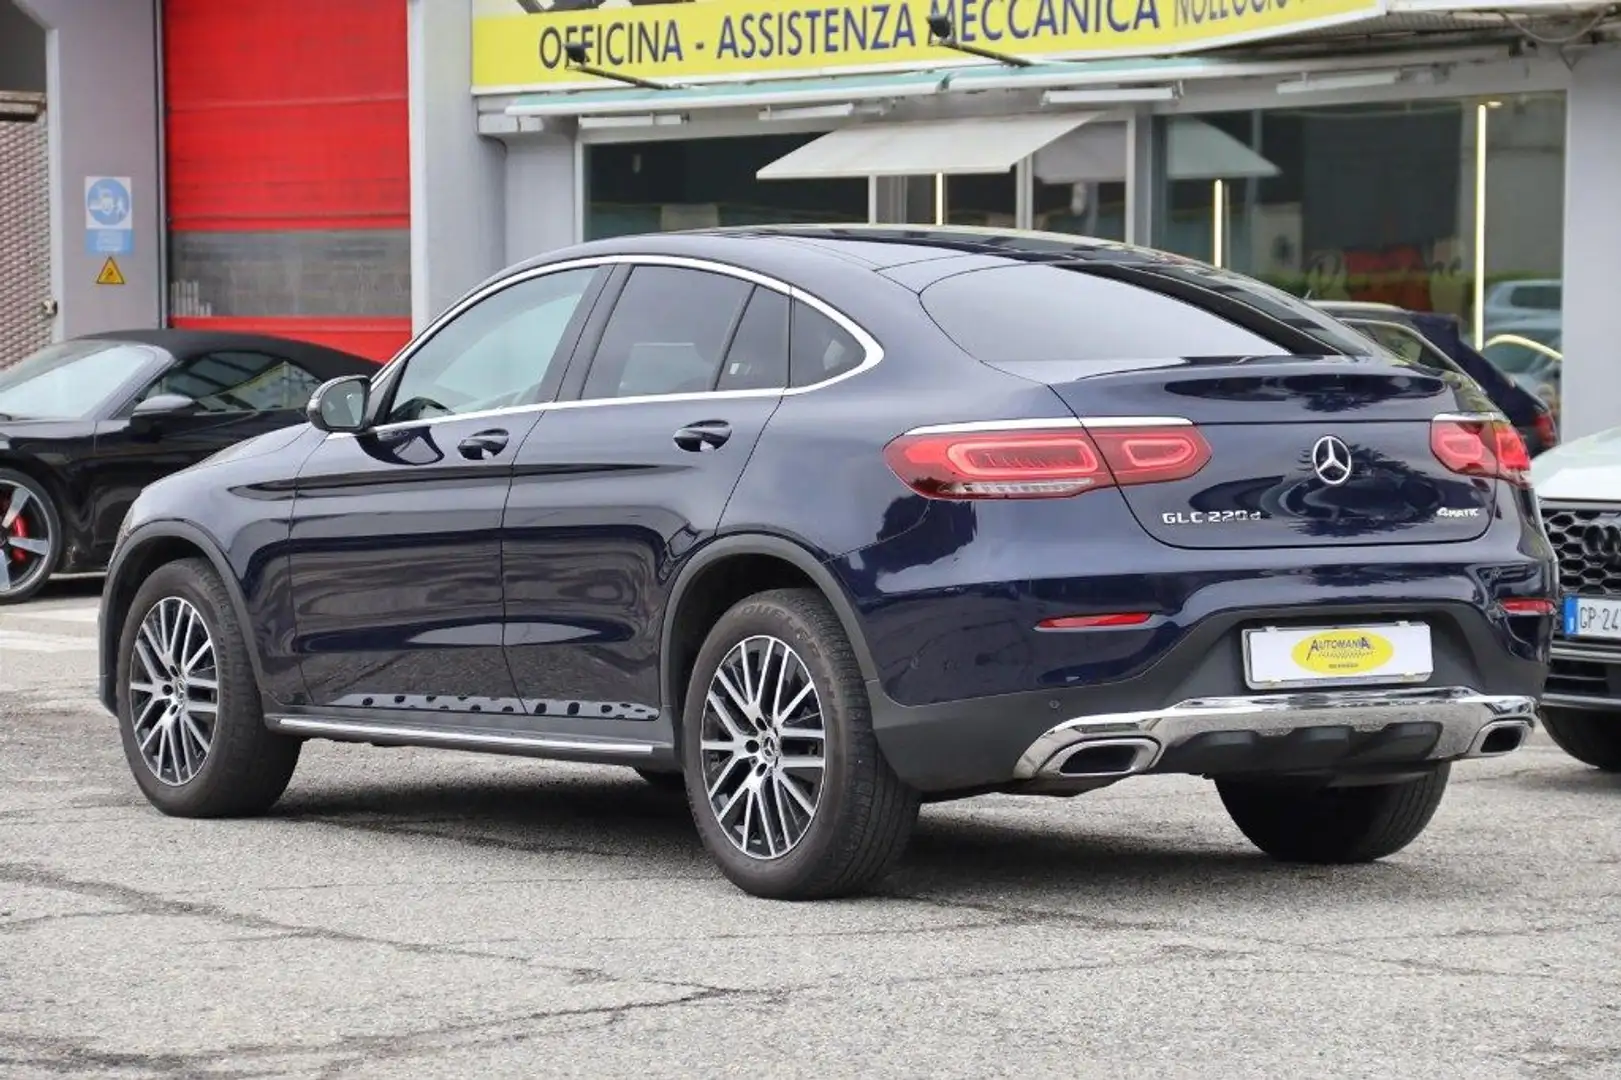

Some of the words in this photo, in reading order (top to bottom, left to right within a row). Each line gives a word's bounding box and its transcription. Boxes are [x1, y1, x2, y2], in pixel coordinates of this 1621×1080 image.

[539, 19, 684, 69] OFFICINA
[716, 3, 916, 59] ASSISTENZA
[927, 0, 1160, 47] MECCANICA
[1162, 511, 1203, 524] GLC
[1580, 606, 1597, 629] GP
